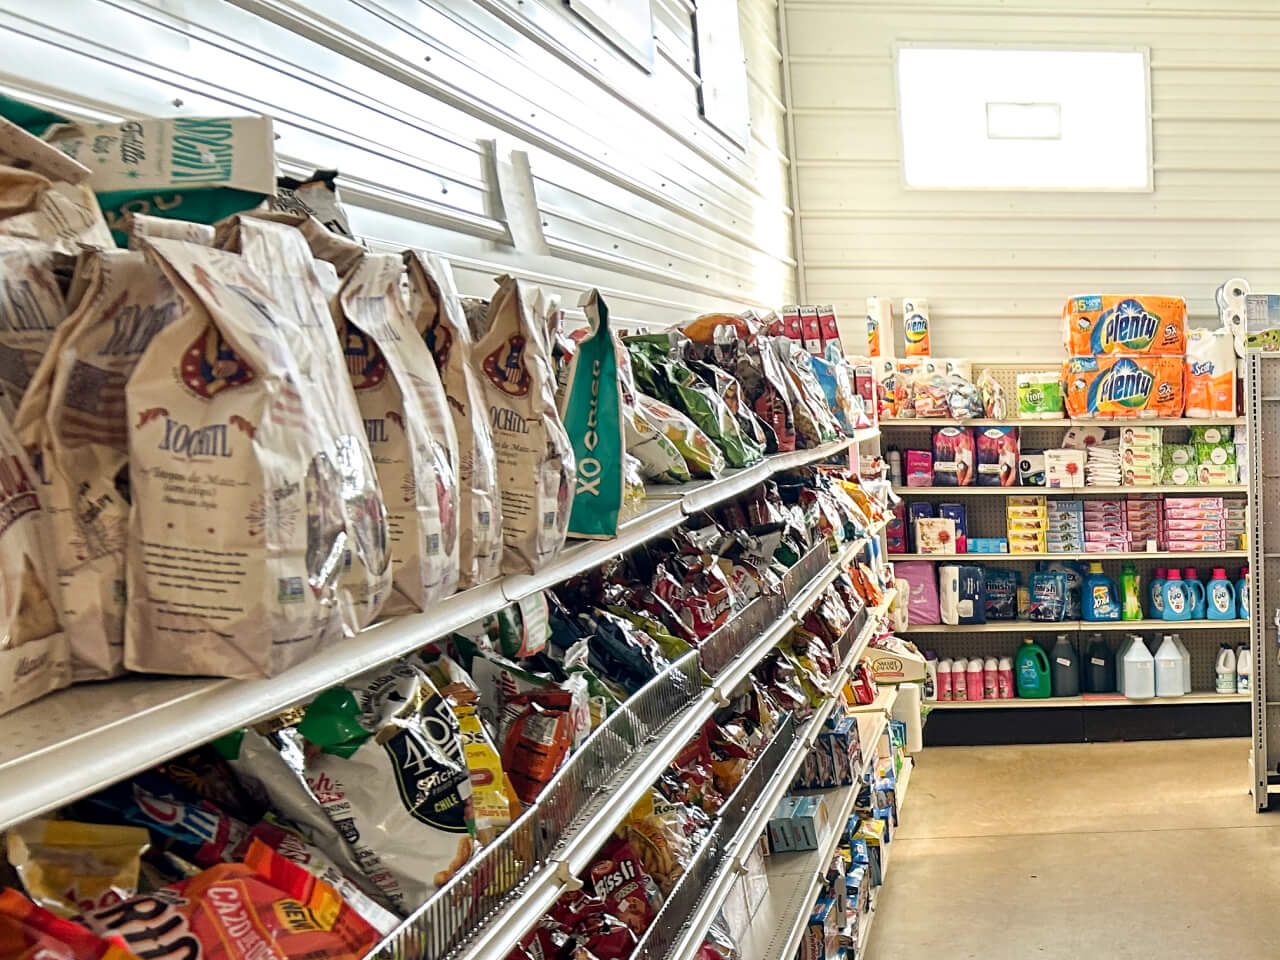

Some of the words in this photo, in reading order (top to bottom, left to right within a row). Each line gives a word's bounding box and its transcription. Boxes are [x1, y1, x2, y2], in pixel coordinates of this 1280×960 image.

[1106, 313, 1156, 345] Plenty
[1101, 371, 1151, 402] Plenty
[986, 580, 1011, 592] finish
[594, 859, 636, 902] Bissli
[207, 886, 247, 955] CAZO
